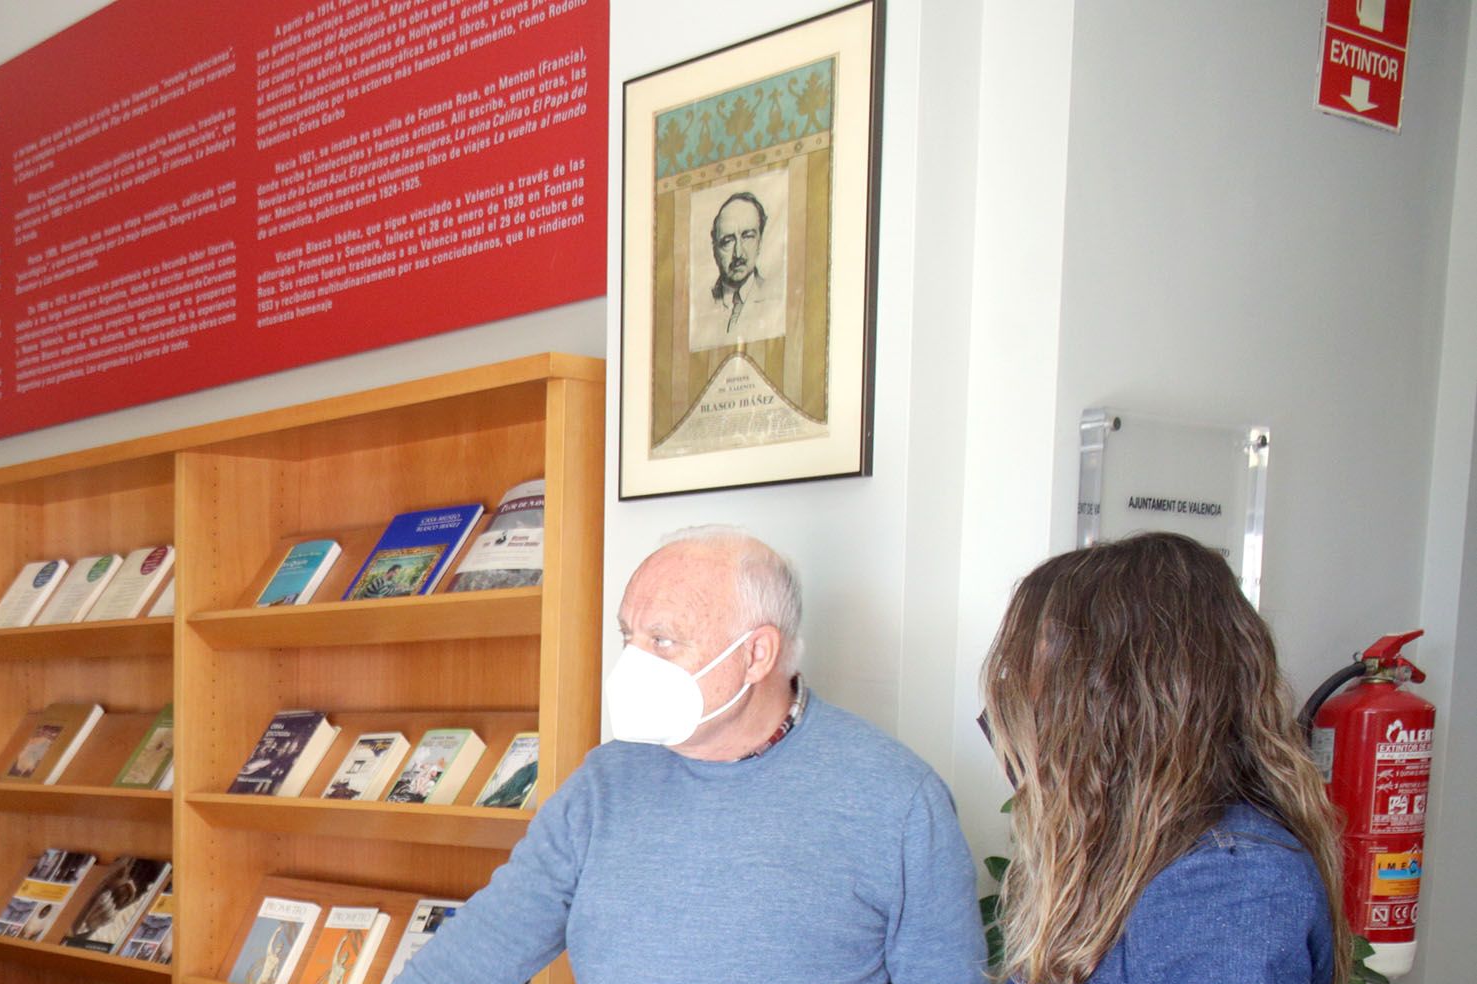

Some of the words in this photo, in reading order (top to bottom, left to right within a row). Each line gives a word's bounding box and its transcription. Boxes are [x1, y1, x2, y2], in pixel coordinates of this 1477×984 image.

[1330, 38, 1399, 82] EXTINTOR
[274, 247, 303, 263] Vicente
[305, 238, 332, 254] Blasco
[365, 222, 381, 237] que
[383, 214, 407, 230] sigue
[409, 199, 452, 222] vinculado
[455, 197, 461, 208] a
[464, 183, 504, 204] Valencia
[507, 180, 514, 191] a
[517, 169, 548, 188] través
[552, 163, 565, 177] de
[568, 158, 585, 172] las
[700, 400, 736, 413] BLASCO
[739, 394, 774, 408] IBÁÑEZ
[1128, 496, 1176, 512] AJUNTAMENT
[1177, 501, 1188, 514] DE
[1189, 501, 1222, 516] VALENCIA
[1379, 744, 1418, 753] EXTINTOR
